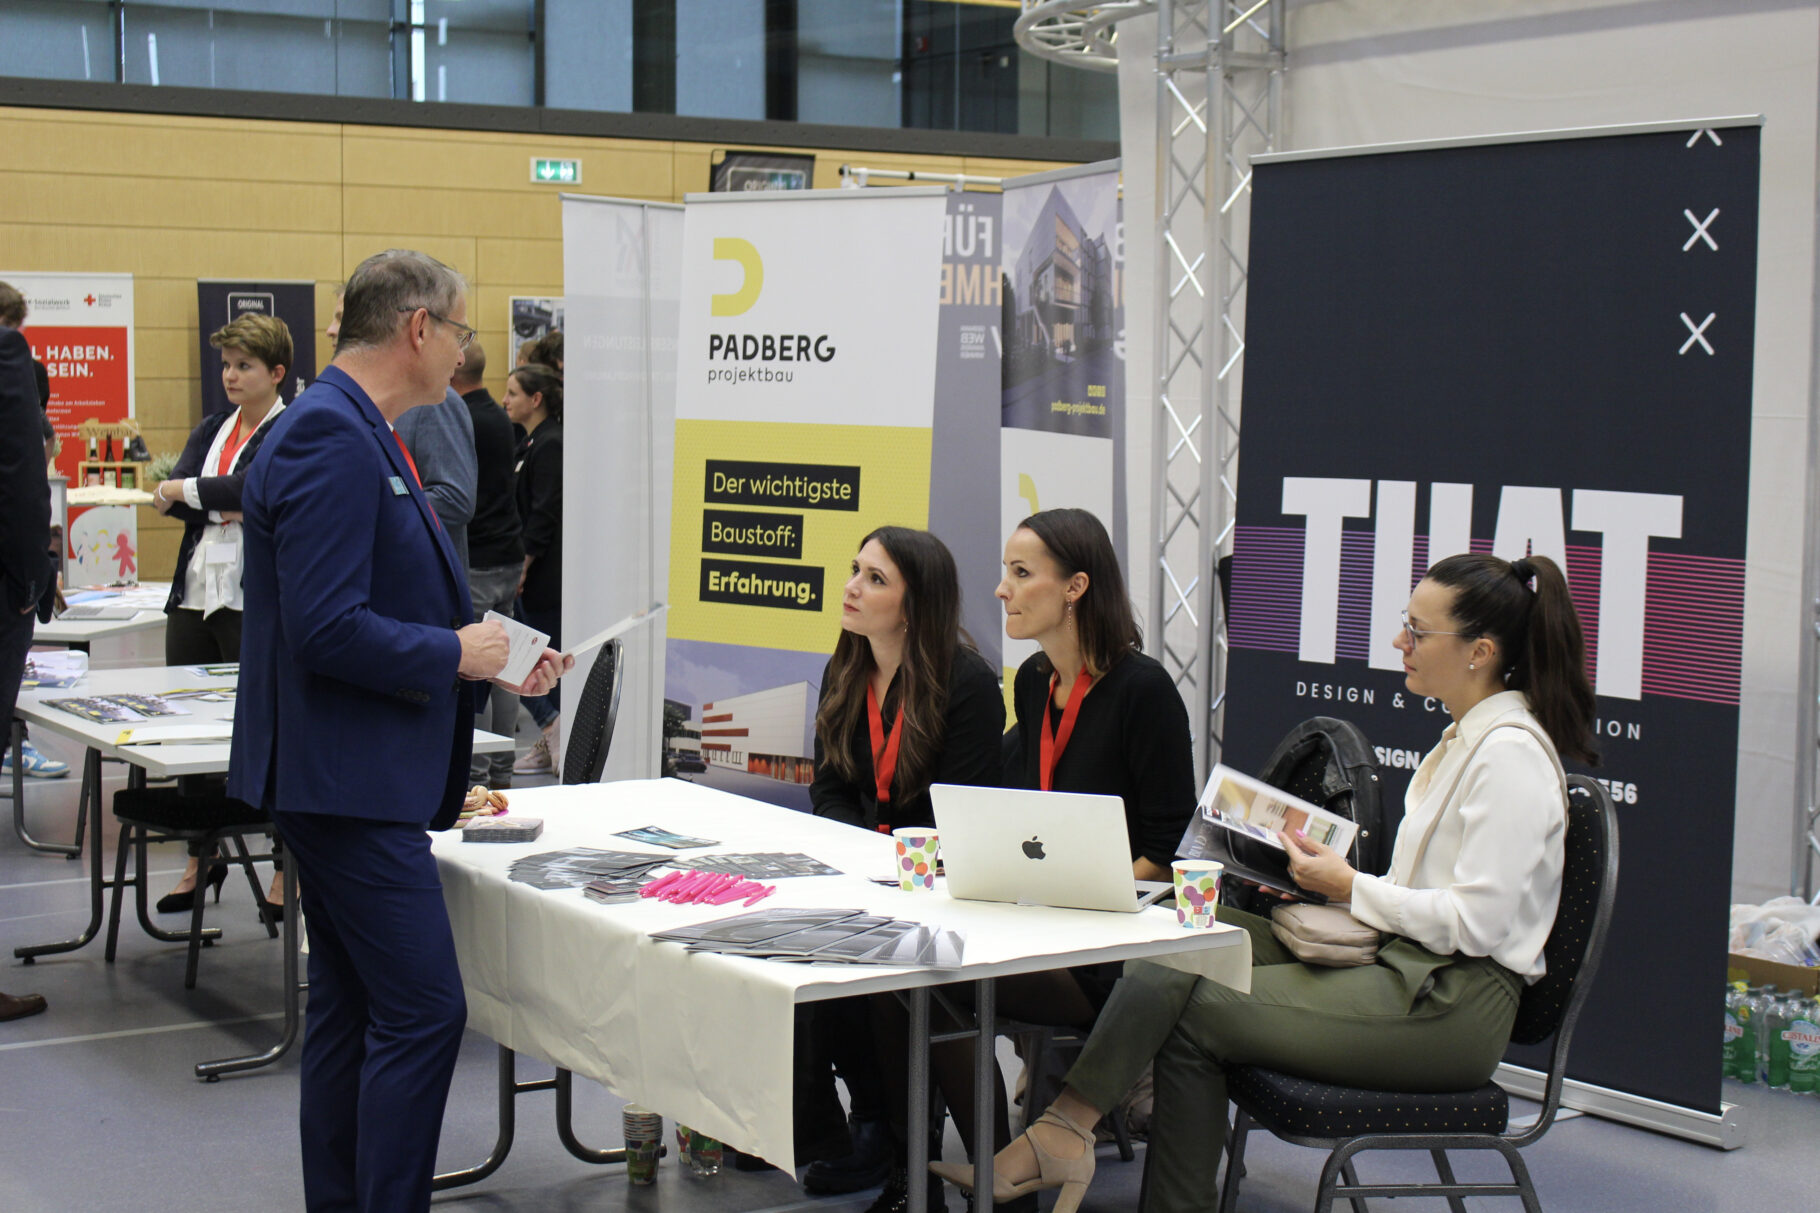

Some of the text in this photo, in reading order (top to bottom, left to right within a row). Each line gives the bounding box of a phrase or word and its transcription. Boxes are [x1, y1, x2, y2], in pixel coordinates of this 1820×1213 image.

[237, 299, 264, 310] ORIGINAL
[46, 345, 115, 361] HABEN.
[709, 333, 837, 363] PADBERG
[47, 362, 94, 378] SEIN.
[708, 366, 794, 386] projektbau
[713, 472, 852, 503] Der wichtigste
[711, 521, 796, 548] Baustoff:
[708, 570, 817, 605] Erfahrung.
[1296, 681, 1375, 704] DESIGN
[1392, 692, 1405, 709] &
